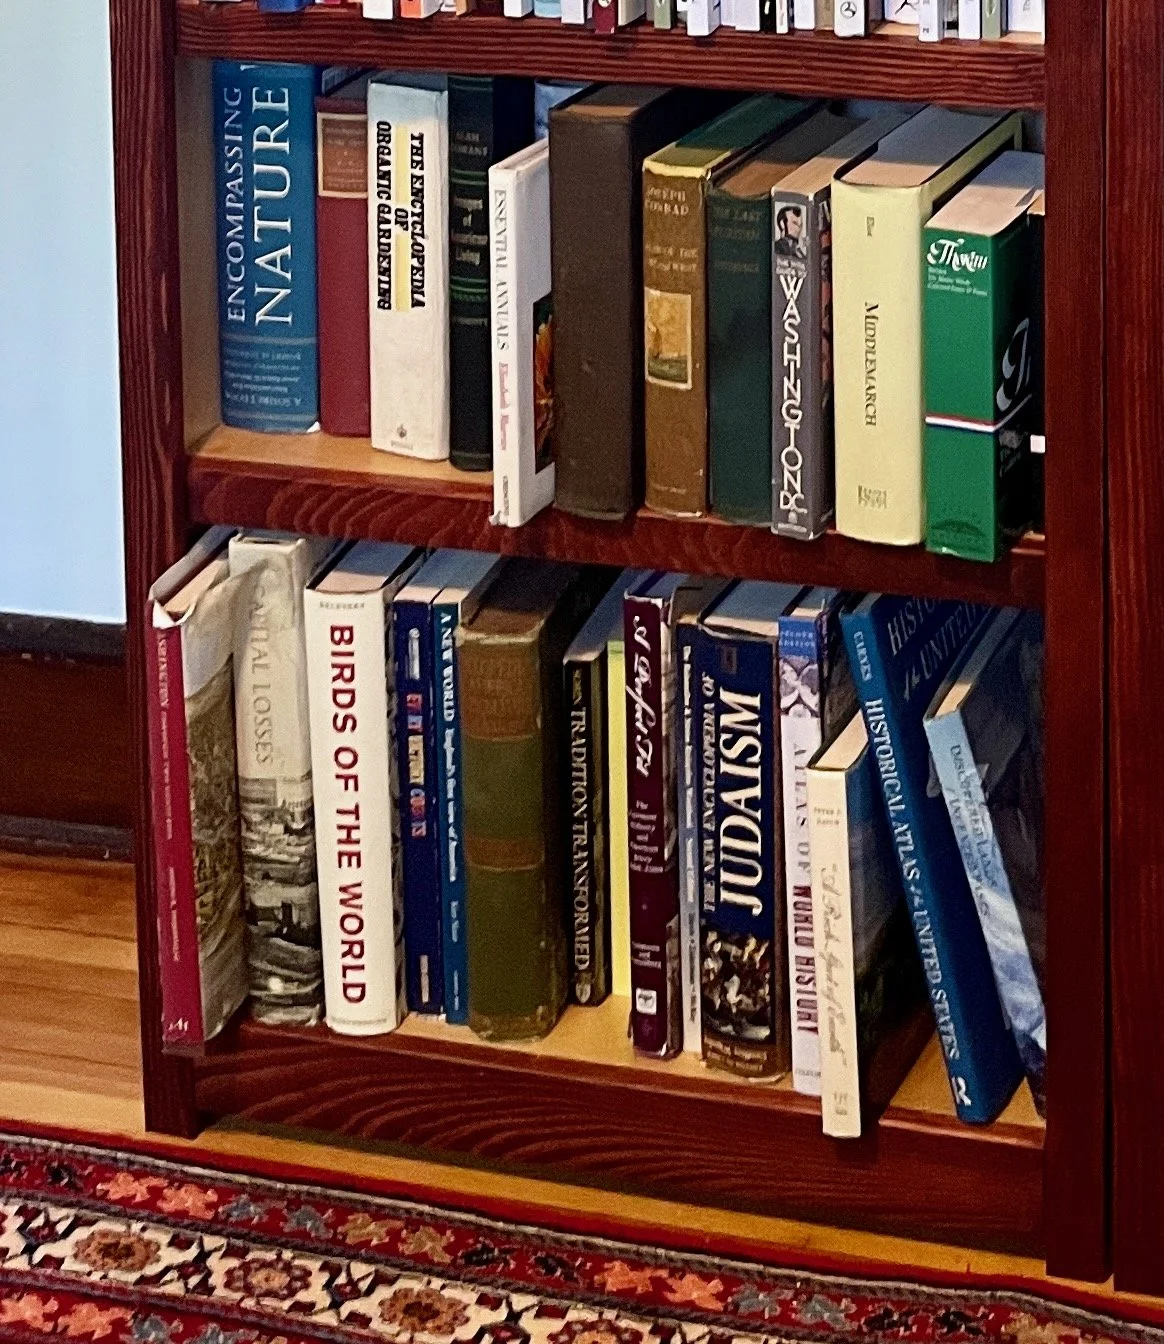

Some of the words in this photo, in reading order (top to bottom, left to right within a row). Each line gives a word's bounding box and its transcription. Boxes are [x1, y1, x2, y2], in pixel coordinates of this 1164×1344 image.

[224, 87, 246, 323] ENCOMPASSING
[253, 86, 293, 326] NATURE
[376, 121, 391, 200] ORGANIC
[410, 133, 423, 170] THE
[377, 203, 391, 310] GARDENING
[394, 208, 408, 231] OF
[410, 174, 425, 308] ENCYCLOPEDIA
[779, 275, 804, 490] WASHINGTON
[864, 303, 880, 427] MIDDLEMARCH
[329, 623, 357, 733] BIRDS
[333, 742, 359, 796] OF
[570, 708, 588, 822] TRADITION
[720, 688, 763, 916] JUDAISM
[337, 807, 361, 871] THE
[572, 823, 591, 971] TRANSFORMED
[865, 698, 904, 818] HISTORICAL
[893, 821, 921, 881] ATLAS
[911, 910, 941, 985] UNITED
[930, 988, 960, 1061] STATES
[339, 879, 367, 1005] WORLD
